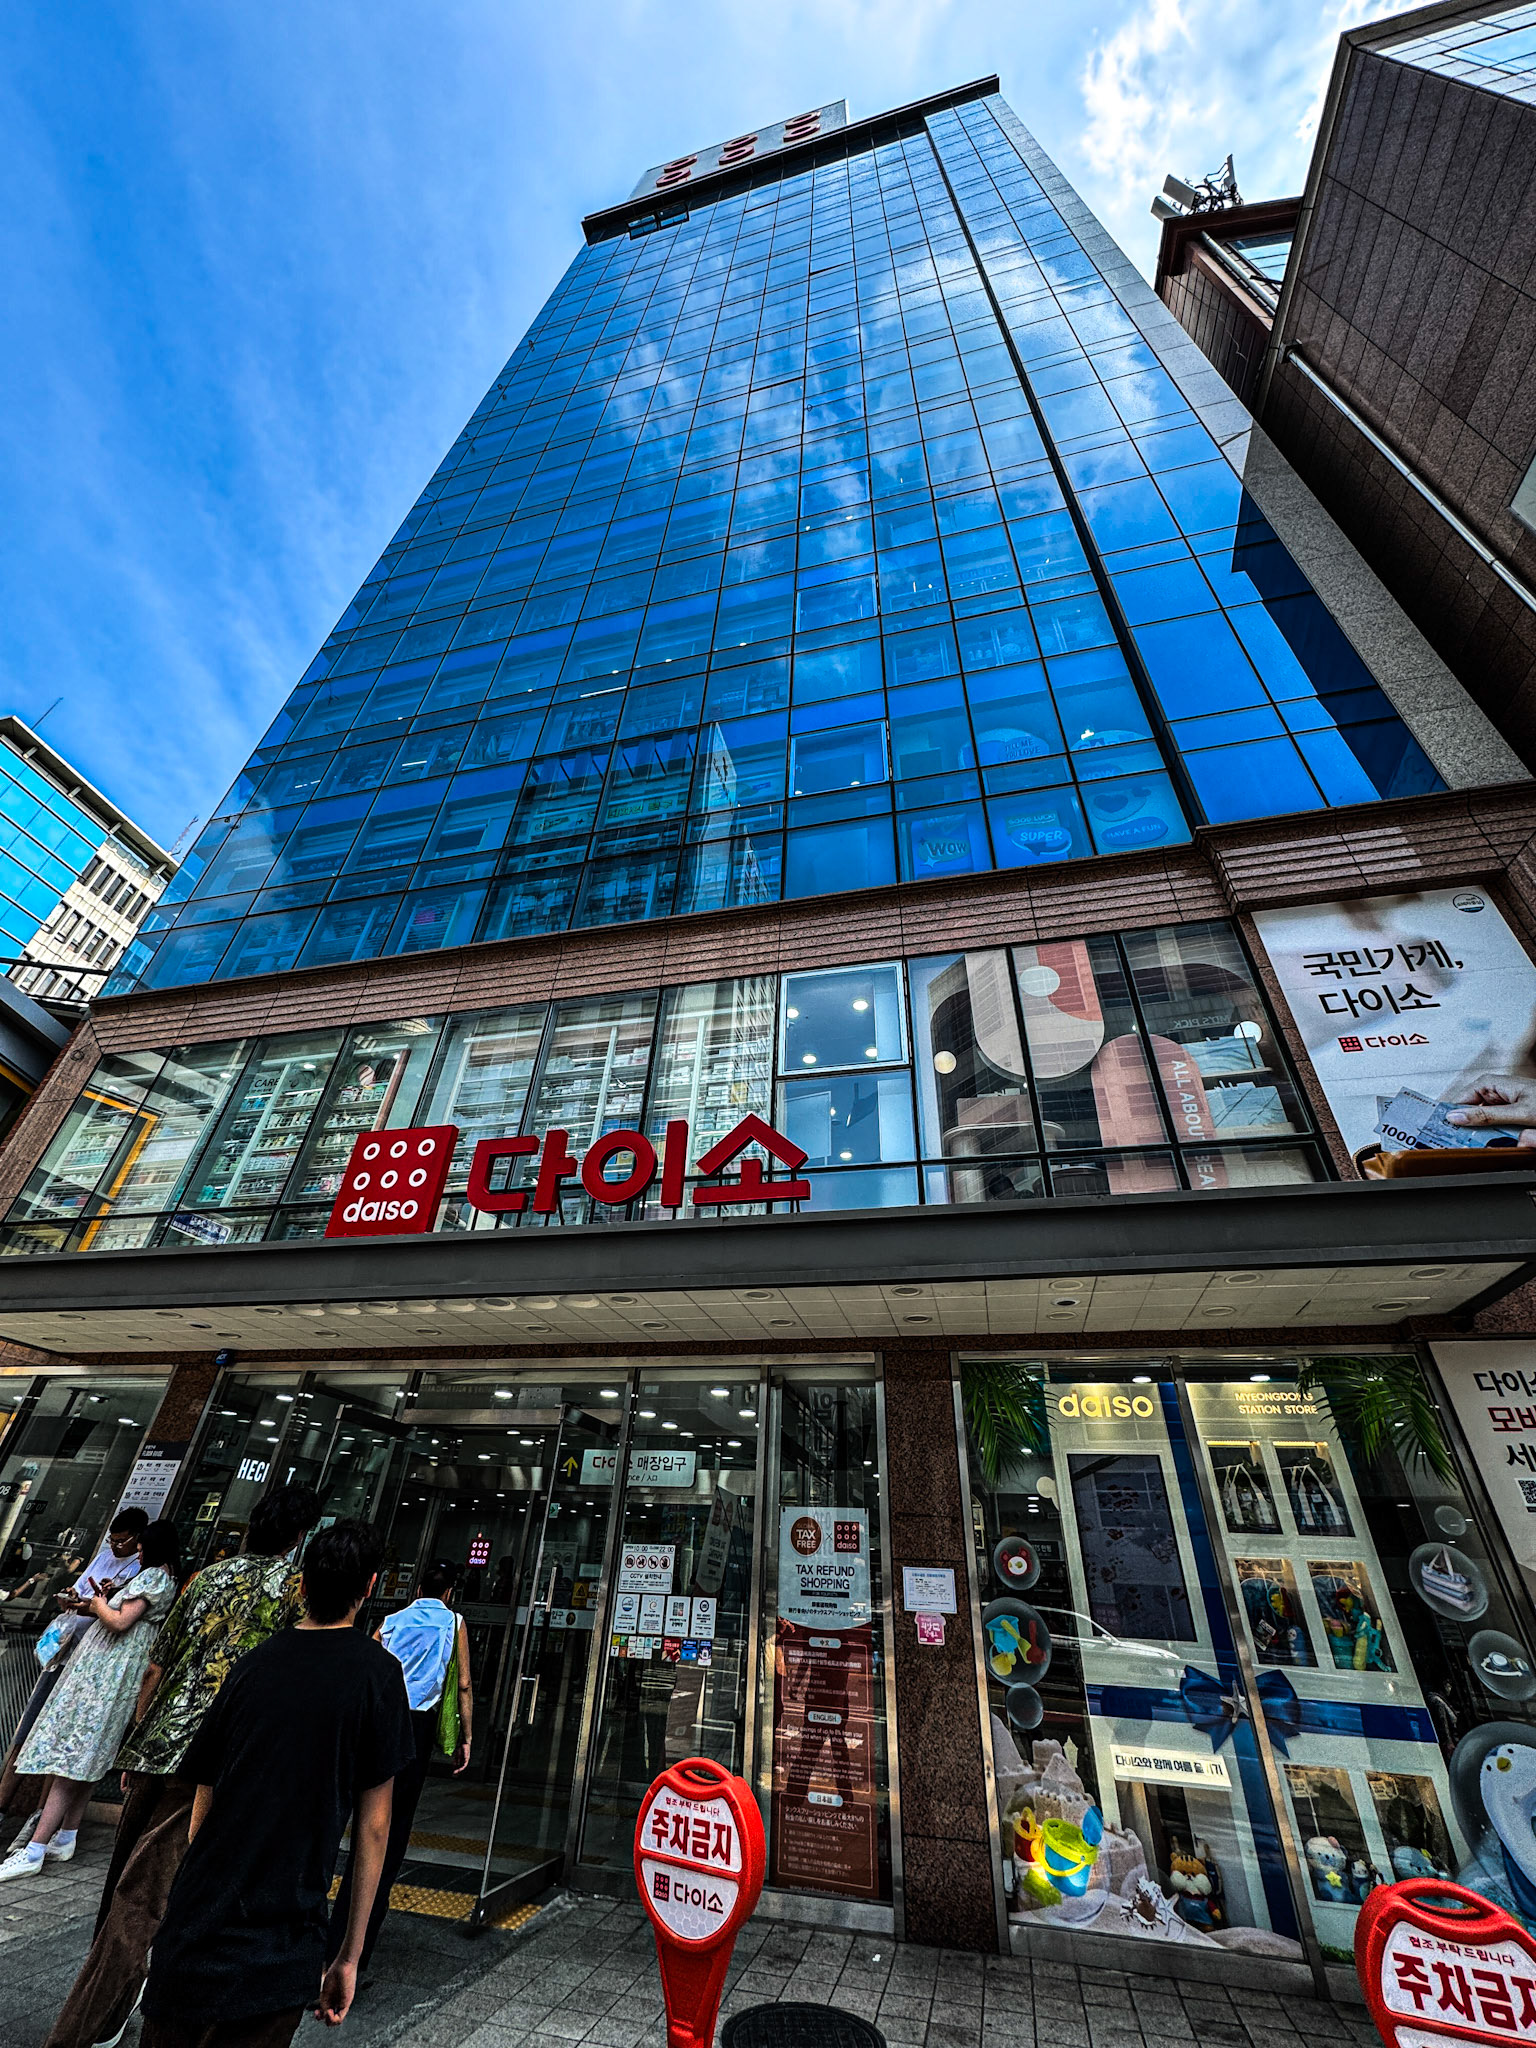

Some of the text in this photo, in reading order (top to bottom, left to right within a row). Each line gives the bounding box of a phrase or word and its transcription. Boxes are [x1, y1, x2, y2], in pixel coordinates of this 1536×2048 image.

[1022, 738, 1033, 747] ME
[1020, 830, 1063, 842] SUPER
[926, 842, 967, 858] WOW
[1303, 940, 1463, 979] 국민가게,
[1318, 983, 1441, 1018] 다이소
[1364, 1033, 1430, 1047] 다이소
[1172, 1060, 1191, 1089] ALL
[254, 1078, 281, 1088] CARE
[1382, 1123, 1417, 1146] 1000
[467, 1112, 811, 1214] 다이소
[343, 1197, 418, 1222] daiso
[1058, 1390, 1154, 1418] daiso
[1239, 1404, 1319, 1415] STATION STORE
[637, 1456, 687, 1472] 매장입구
[796, 1529, 816, 1540] TAX
[796, 1540, 817, 1549] FREE
[837, 1541, 857, 1550] daiso
[796, 1564, 855, 1577] TAX REFUND
[801, 1577, 850, 1590] SHOPPING
[813, 1713, 837, 1723] ENGLISH
[665, 1797, 720, 1816] 협조 부탁 드립니다
[652, 1808, 732, 1866] 주차금지
[674, 1882, 724, 1914] 다이소
[1408, 1935, 1515, 1967] 협조 부탁 드립니다
